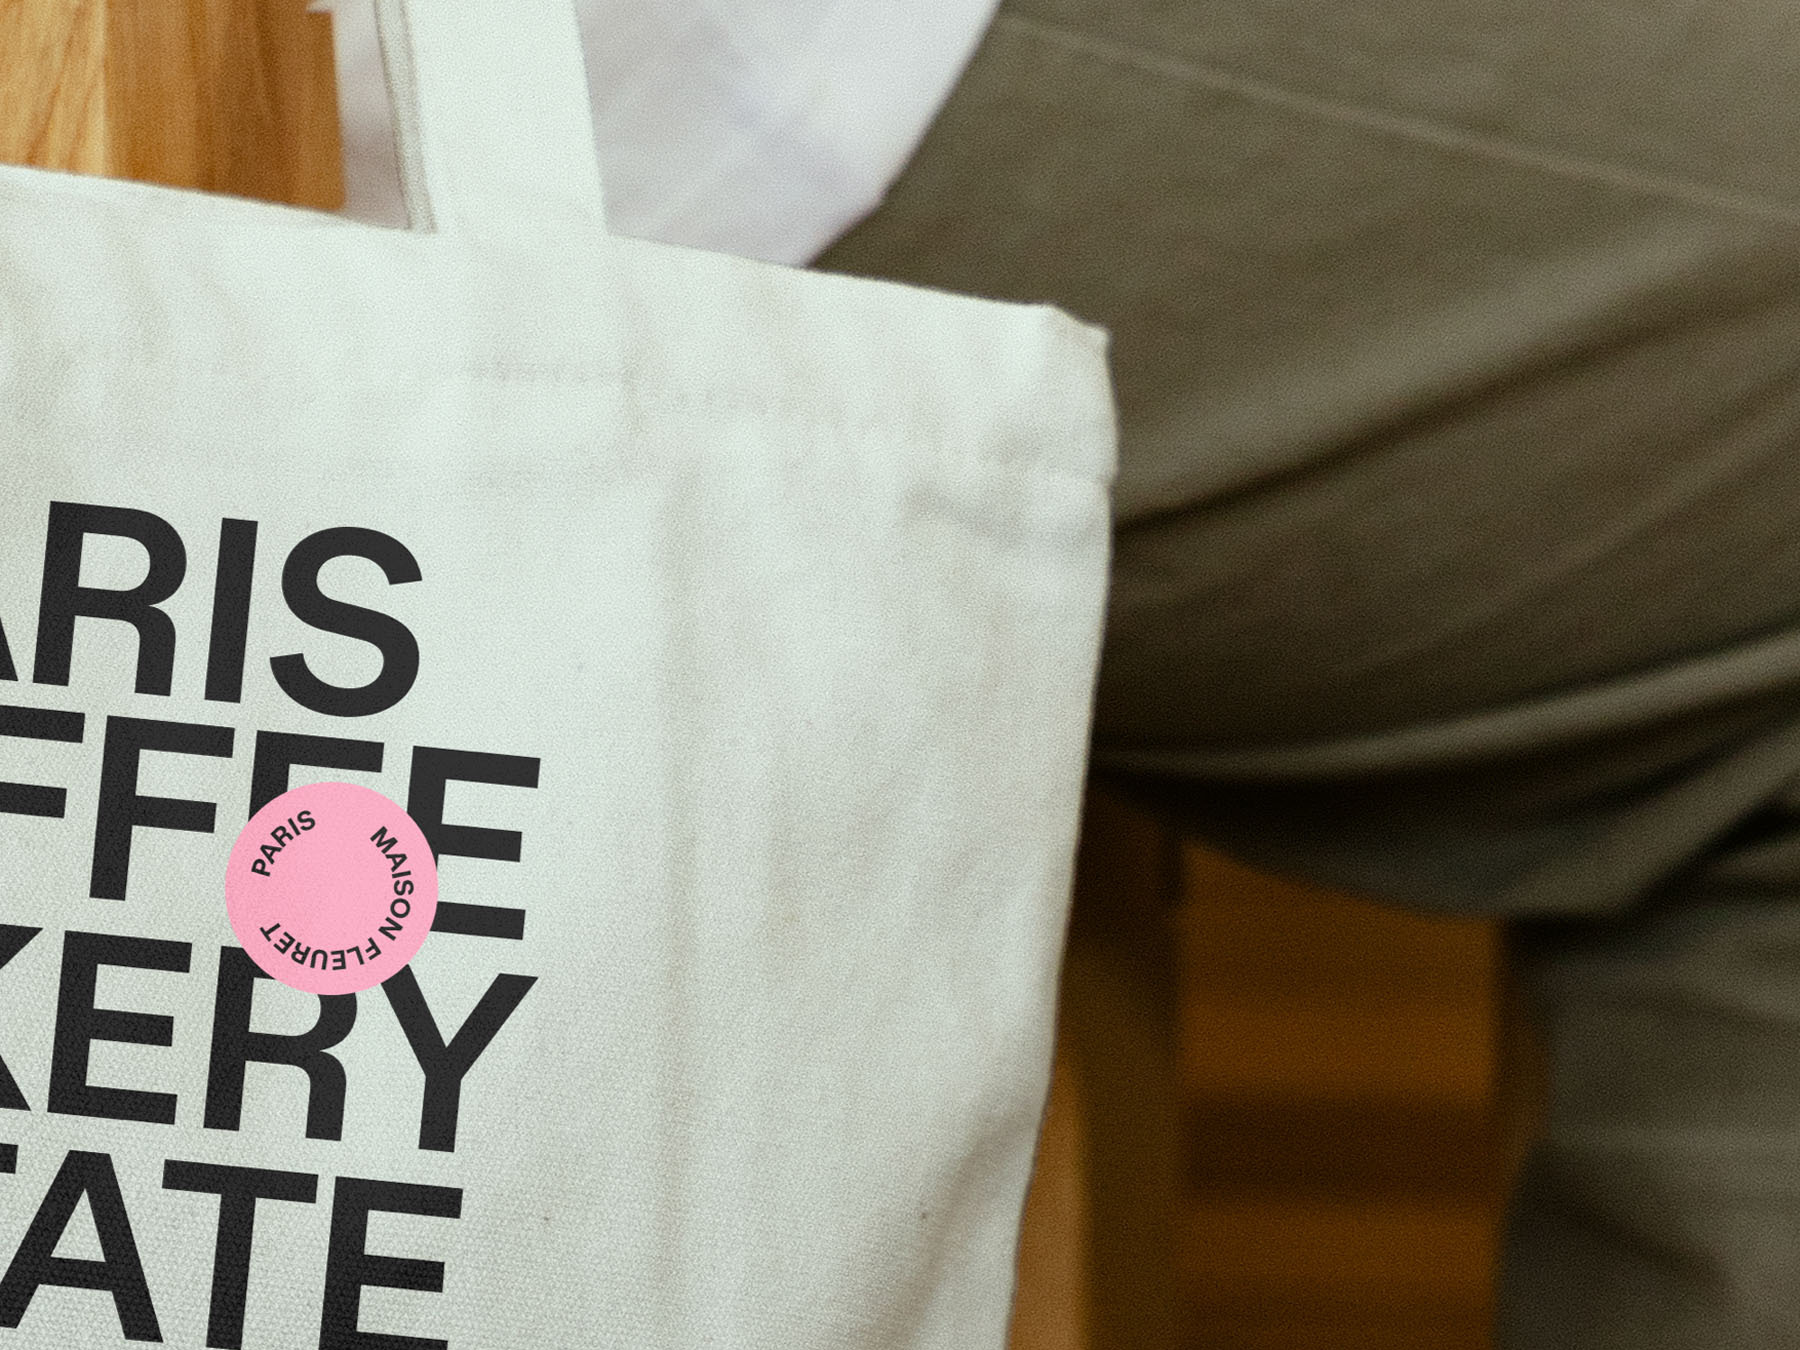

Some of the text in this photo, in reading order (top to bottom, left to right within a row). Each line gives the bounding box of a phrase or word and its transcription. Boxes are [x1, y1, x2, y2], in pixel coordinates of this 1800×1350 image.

[251, 810, 316, 877] PARIS
[259, 826, 414, 971] MAISON FLEURET
